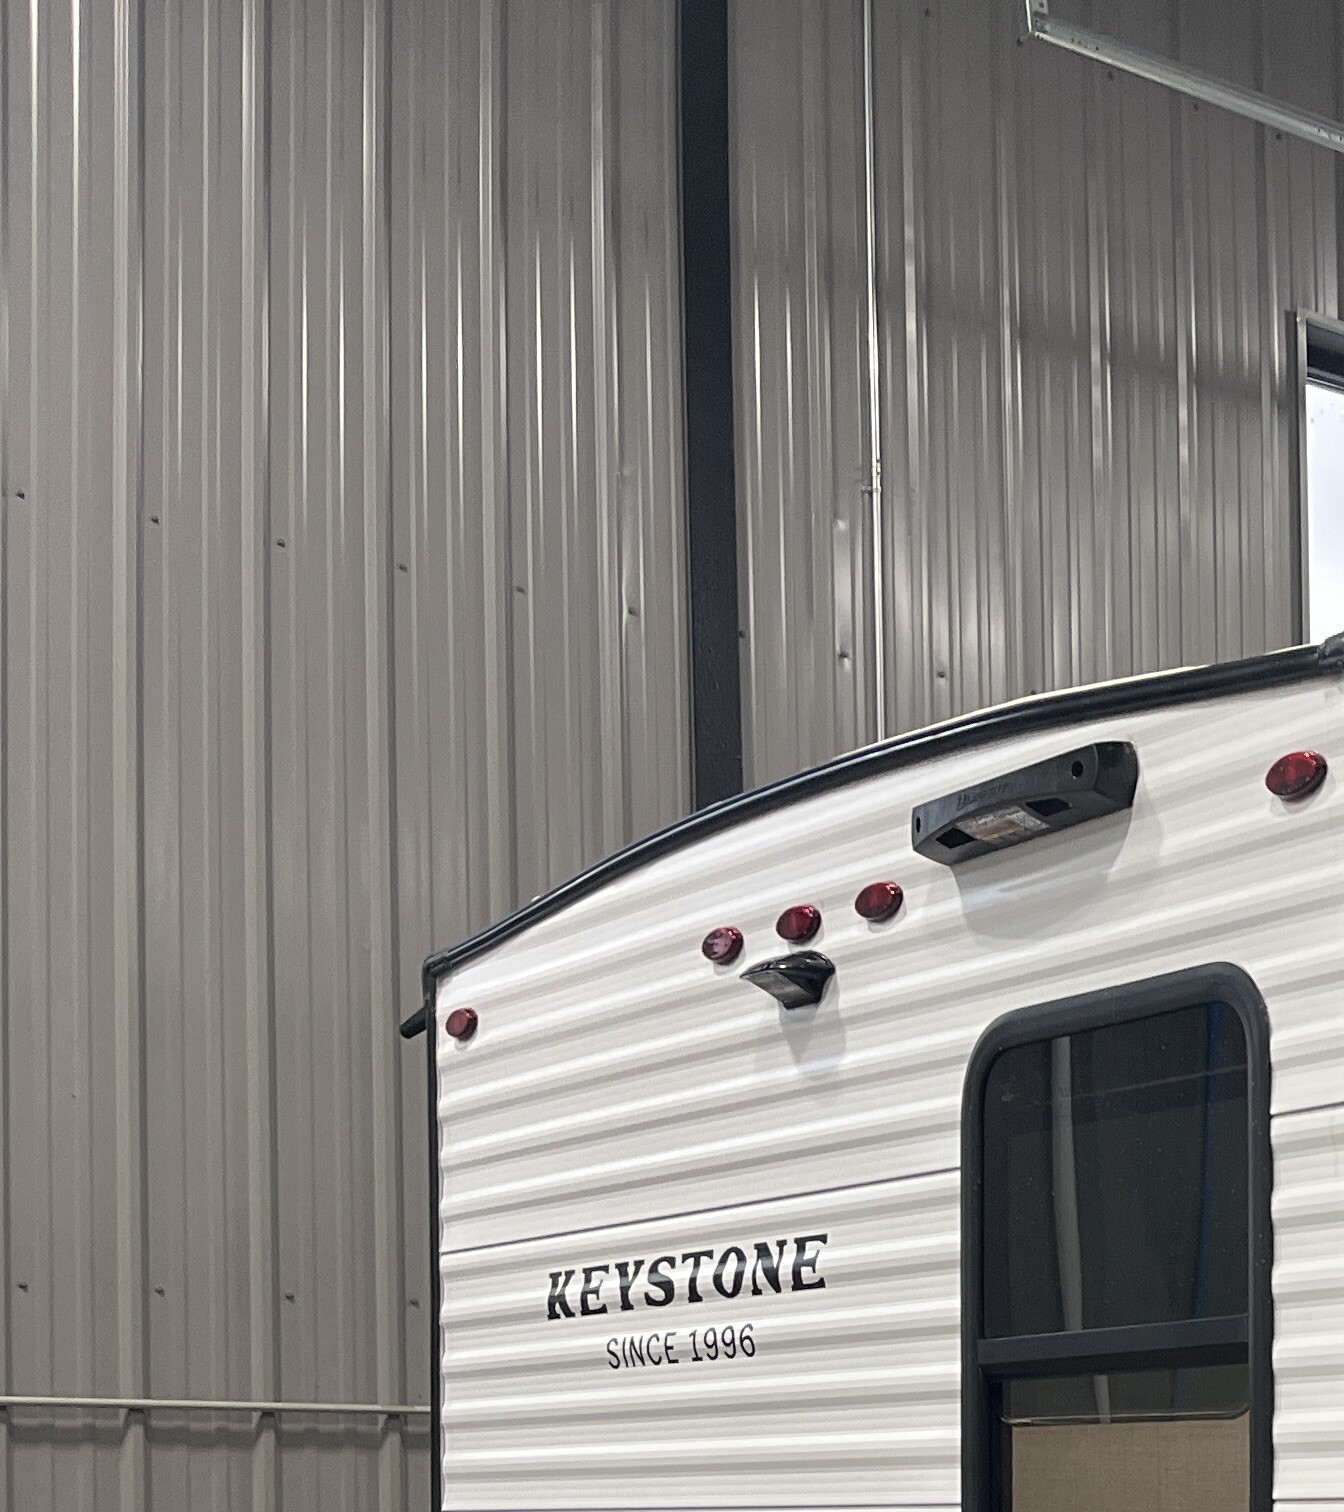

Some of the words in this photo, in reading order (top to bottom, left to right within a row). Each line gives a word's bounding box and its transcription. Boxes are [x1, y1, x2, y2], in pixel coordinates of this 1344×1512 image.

[547, 1233, 828, 1321] KEYSTONE
[606, 1331, 680, 1370] SINCE
[688, 1323, 757, 1363] 1996
